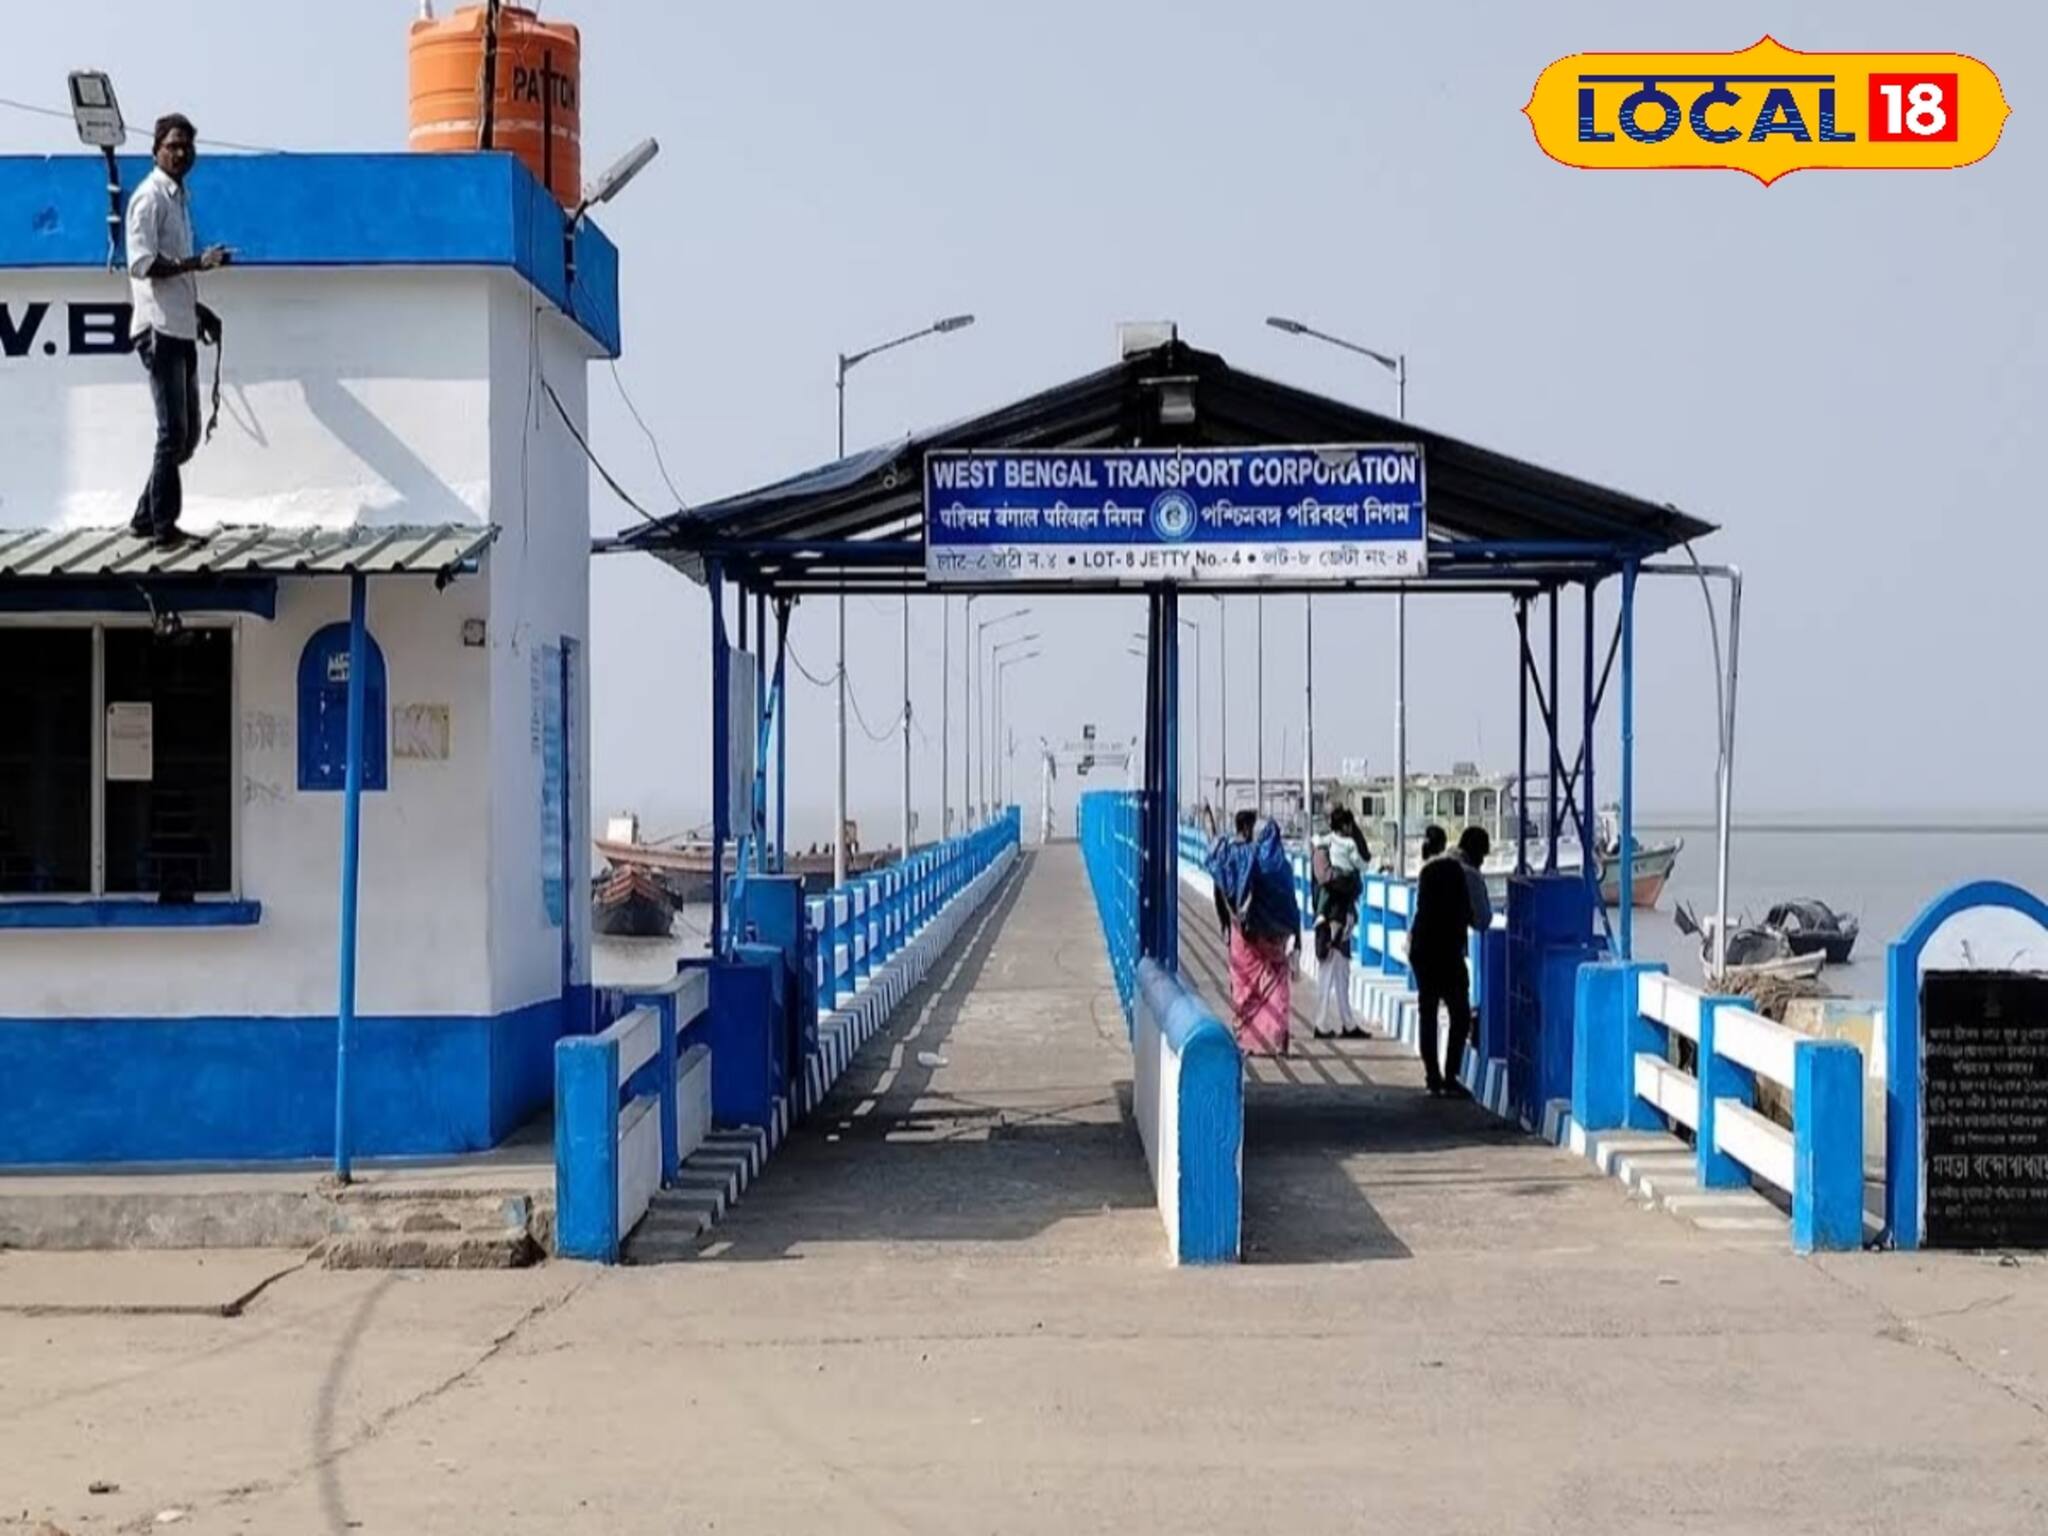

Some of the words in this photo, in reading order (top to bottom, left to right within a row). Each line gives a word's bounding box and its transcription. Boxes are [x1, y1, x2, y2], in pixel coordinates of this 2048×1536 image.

[934, 460, 998, 489] WEST
[1005, 459, 1098, 488] BENGAL
[1104, 457, 1242, 487] TRANSPORT
[1249, 455, 1416, 486] CORPORATION
[994, 501, 1039, 528] बंगाल
[1043, 500, 1099, 530] परिवहन
[1103, 500, 1144, 528] निगम
[1364, 496, 1410, 526] নিগম
[1140, 551, 1190, 567] JETTY
